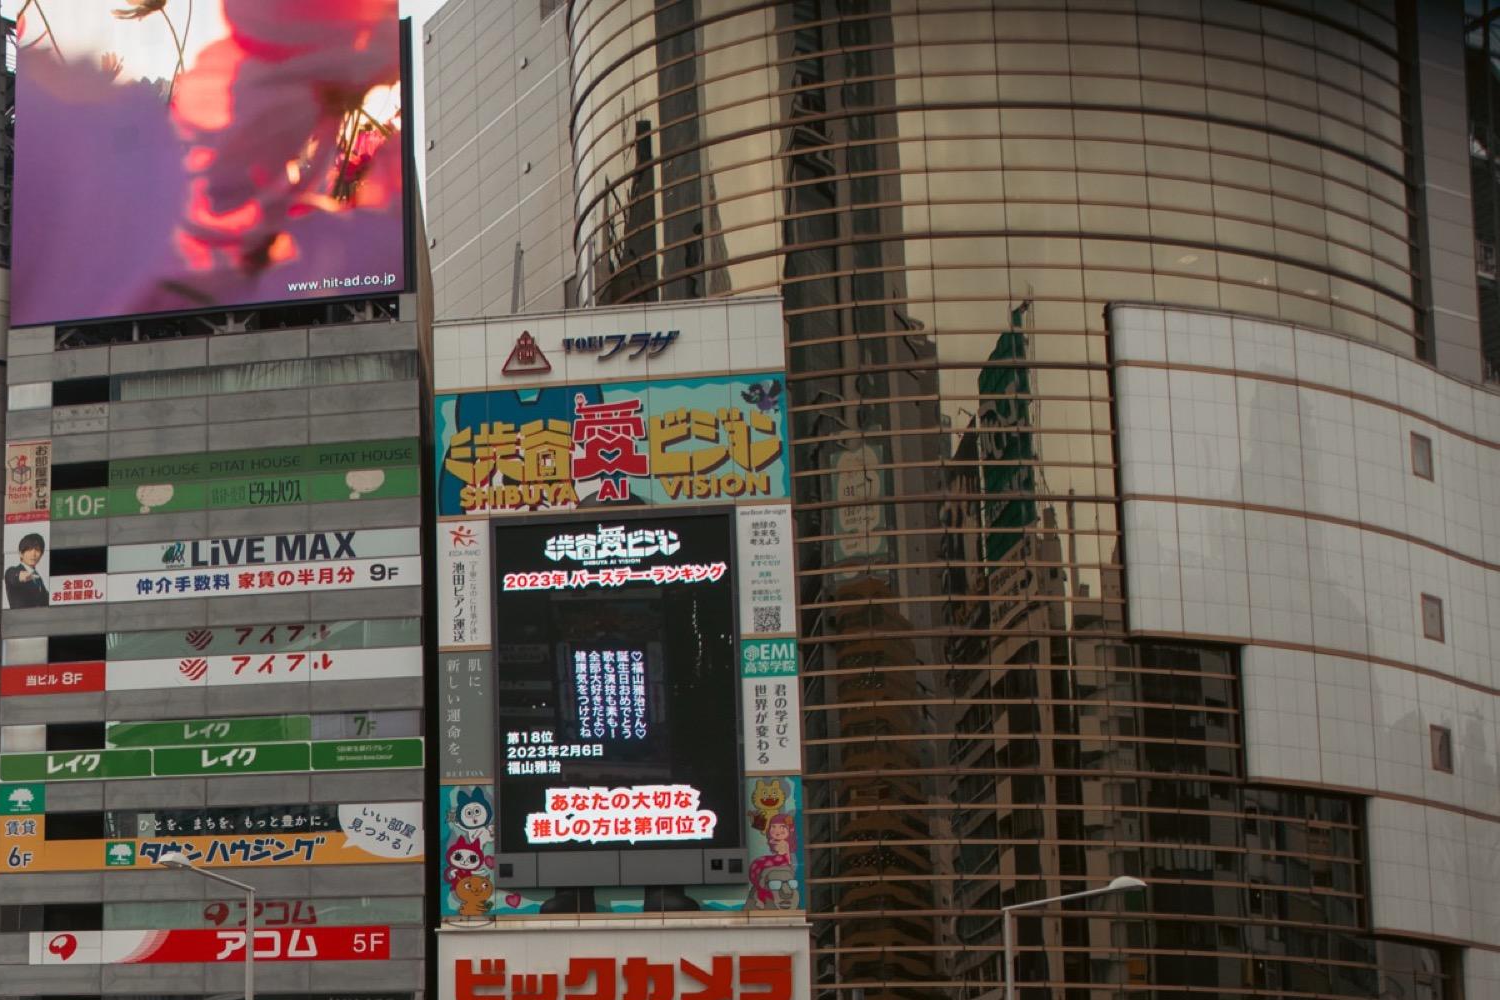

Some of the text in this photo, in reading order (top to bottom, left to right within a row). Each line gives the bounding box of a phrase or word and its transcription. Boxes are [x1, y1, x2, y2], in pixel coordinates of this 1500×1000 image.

[287, 272, 396, 292] www.hit-ad.co.jp
[210, 456, 301, 473] PITAT HOUSE
[320, 448, 412, 465] PITAT HOUSE
[111, 464, 199, 480] PITAT HOUSE
[460, 473, 770, 509] SHIBUYA AI VISION
[65, 495, 105, 516] 10F
[276, 531, 357, 562] MAX
[62, 579, 94, 589] 全国の
[136, 564, 399, 595] 仲介手数料 家賃の半月分 9F
[504, 572, 567, 590] 2023年
[452, 561, 466, 642] 池田ピアノ運送
[759, 644, 795, 661] EMI
[231, 653, 333, 675] アイフル
[744, 659, 795, 674] 高等学院
[25, 672, 83, 686] 当ビル 8F
[354, 716, 377, 735] 7F
[754, 685, 770, 764] 世界が変わる
[774, 684, 789, 748] 君の学びで
[183, 722, 231, 740] レイク
[506, 731, 554, 745] 第18位
[202, 748, 257, 767] レイク
[506, 743, 604, 758] 2023年2月6日
[47, 754, 100, 774] レイク
[507, 760, 562, 775] 福山雅治
[550, 790, 693, 812] あなたの大切な
[4, 819, 37, 836] 賃貸
[362, 806, 417, 838] いい部屋
[532, 815, 713, 839] 推しの方は第何位？
[8, 847, 33, 867] 6F
[216, 929, 384, 960] アコム 5F
